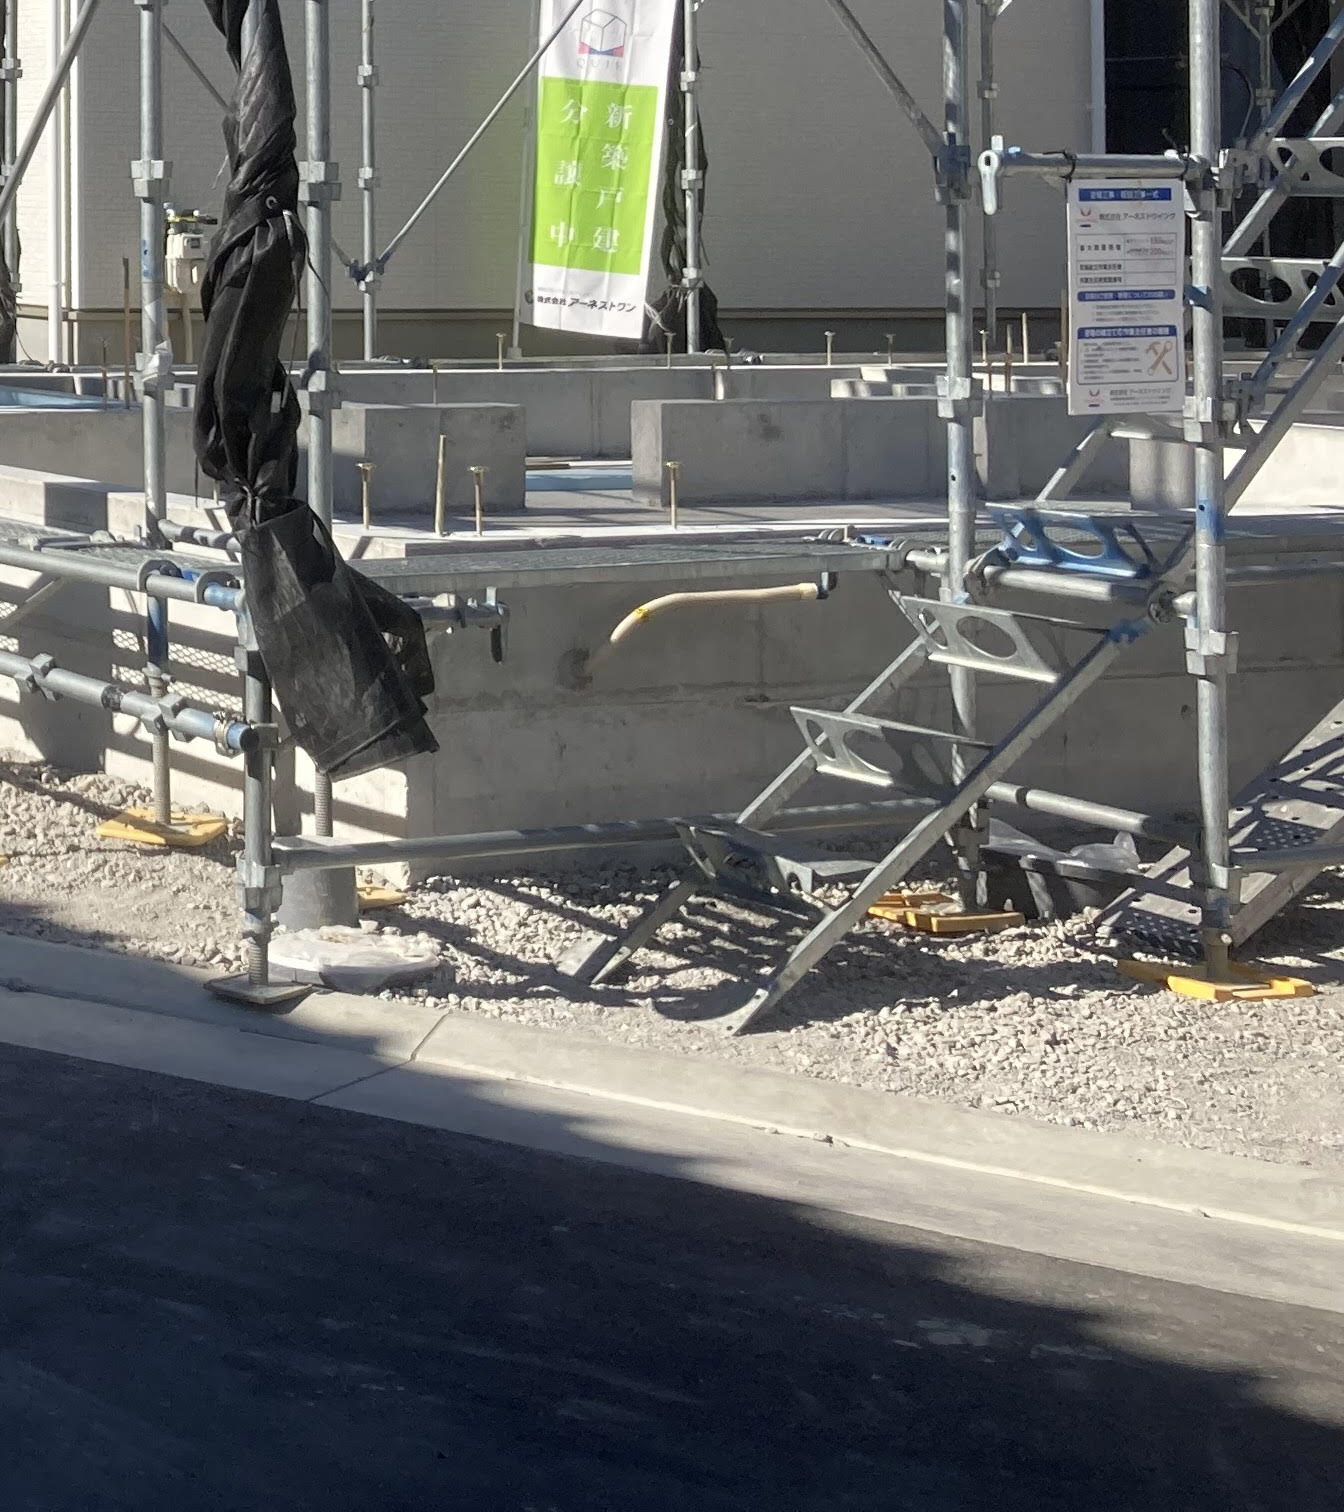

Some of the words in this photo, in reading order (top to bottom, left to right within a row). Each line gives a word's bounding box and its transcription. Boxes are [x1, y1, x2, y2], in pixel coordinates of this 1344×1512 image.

[549, 99, 588, 248] 分譲中
[592, 102, 633, 253] 新築戸建
[537, 295, 567, 306] 株式会社
[568, 297, 637, 312] アーネストワン
